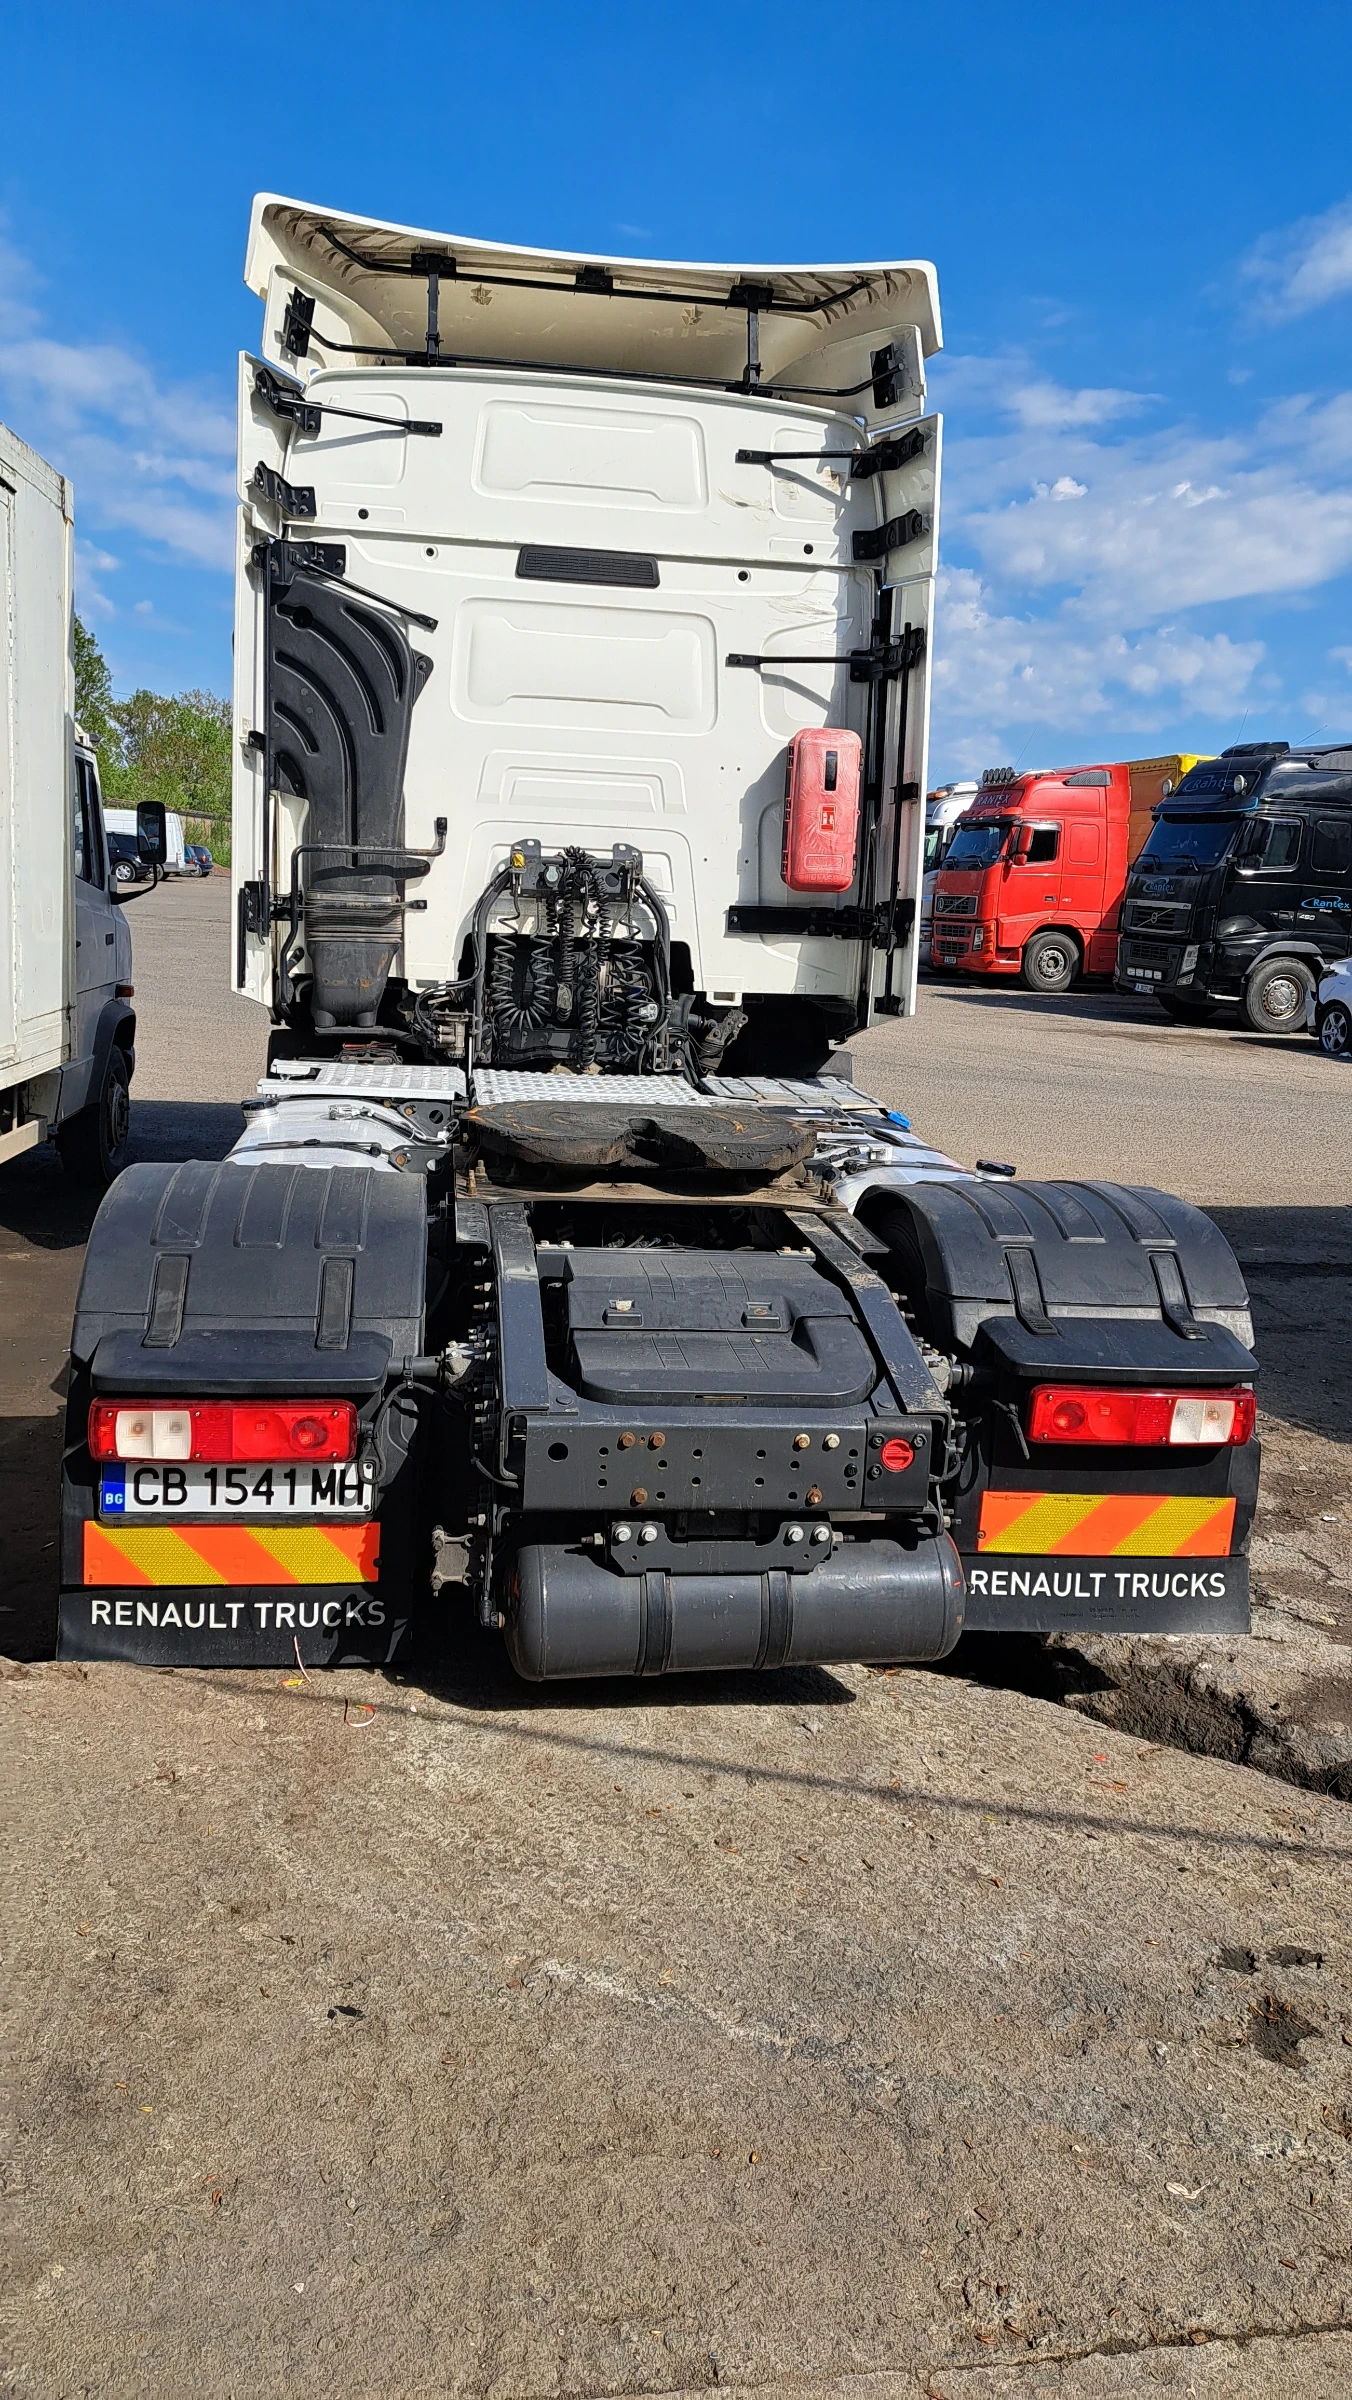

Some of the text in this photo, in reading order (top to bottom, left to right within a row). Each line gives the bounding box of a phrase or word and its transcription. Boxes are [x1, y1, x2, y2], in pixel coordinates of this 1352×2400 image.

[977, 793, 1012, 805] RANTEX
[1150, 881, 1175, 891] Rantex
[1313, 898, 1350, 909] Rantex
[133, 1467, 364, 1507] CB 1541 MH
[105, 1492, 124, 1505] BG
[971, 1569, 1226, 1598] RENAULT TRUCKS
[91, 1600, 386, 1629] RENAULT TRUCKS
